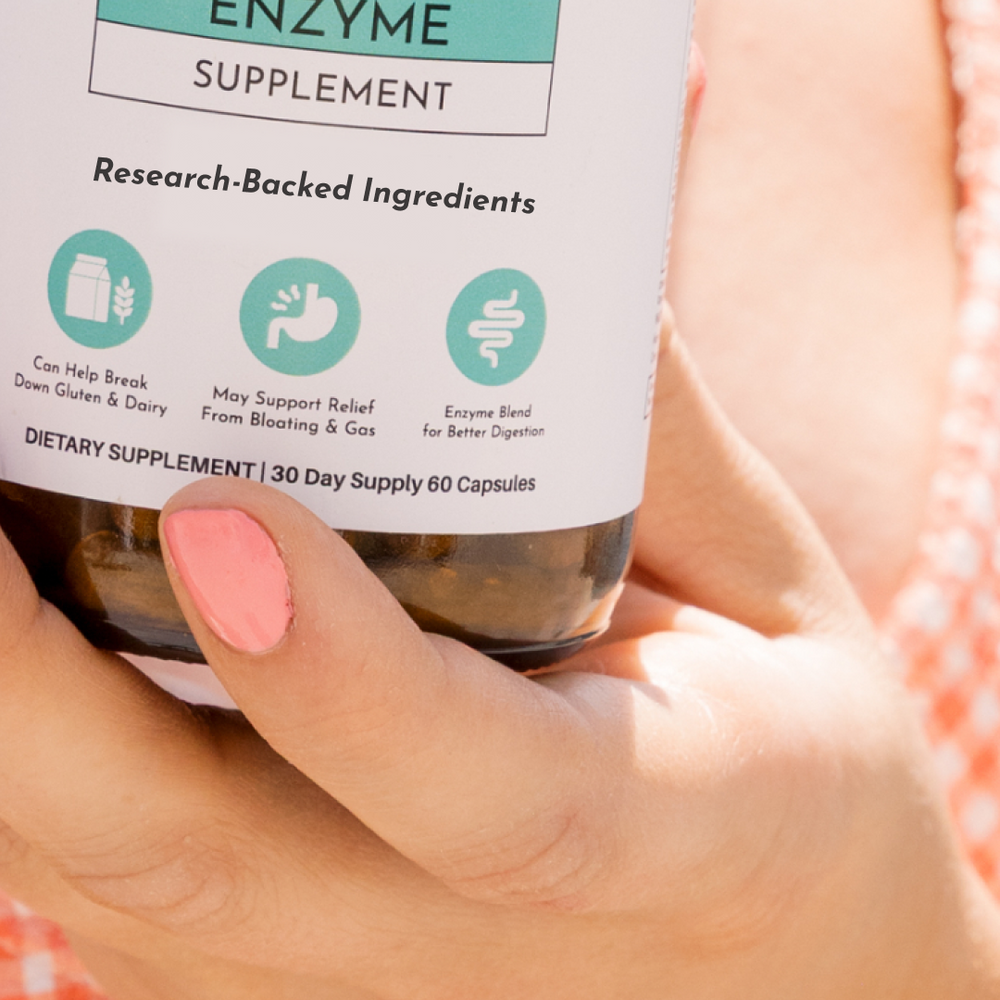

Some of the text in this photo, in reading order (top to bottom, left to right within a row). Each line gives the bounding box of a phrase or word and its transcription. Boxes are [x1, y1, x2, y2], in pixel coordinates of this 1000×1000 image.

[192, 59, 453, 111] SUPPLEMENT
[93, 156, 536, 215] Research-Backed Ingredients
[33, 354, 148, 390] Can Help Break
[14, 371, 168, 418] Down Gluten & Dairy
[212, 385, 376, 415] May Support Relief
[201, 405, 376, 437] From Bloating & Gas
[444, 404, 532, 422] Enzyme Blend
[422, 422, 545, 441] for Better Digestion
[25, 426, 105, 458] DIETARY
[108, 443, 257, 480] SUPPLEMENT
[270, 464, 299, 484] 30
[304, 468, 346, 492] Day
[350, 471, 423, 497] Supply
[427, 475, 453, 493] 60
[457, 475, 536, 497] Capsules
